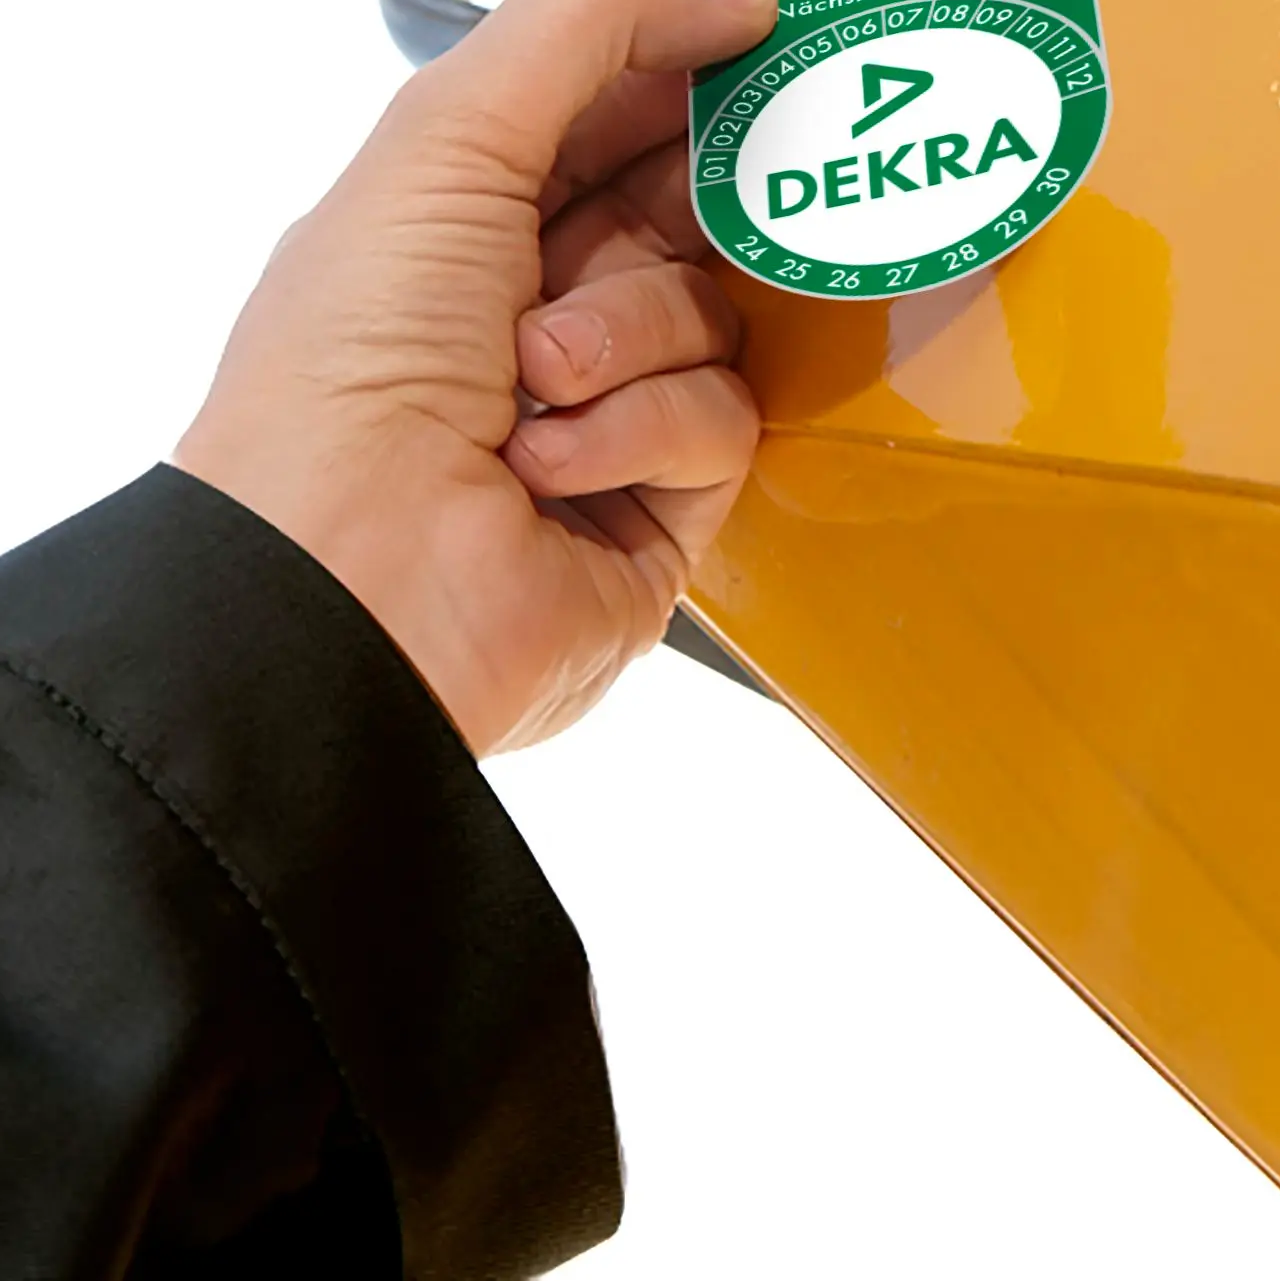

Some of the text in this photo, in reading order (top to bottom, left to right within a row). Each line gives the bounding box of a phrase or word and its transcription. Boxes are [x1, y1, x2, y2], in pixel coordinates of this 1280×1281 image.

[703, 3, 1094, 178] 01 02 03 04 05 06 07 08 09 10 11 12
[734, 165, 1072, 290] 24 25 26 27 28 29 30
[766, 117, 1038, 220] DEKRA
